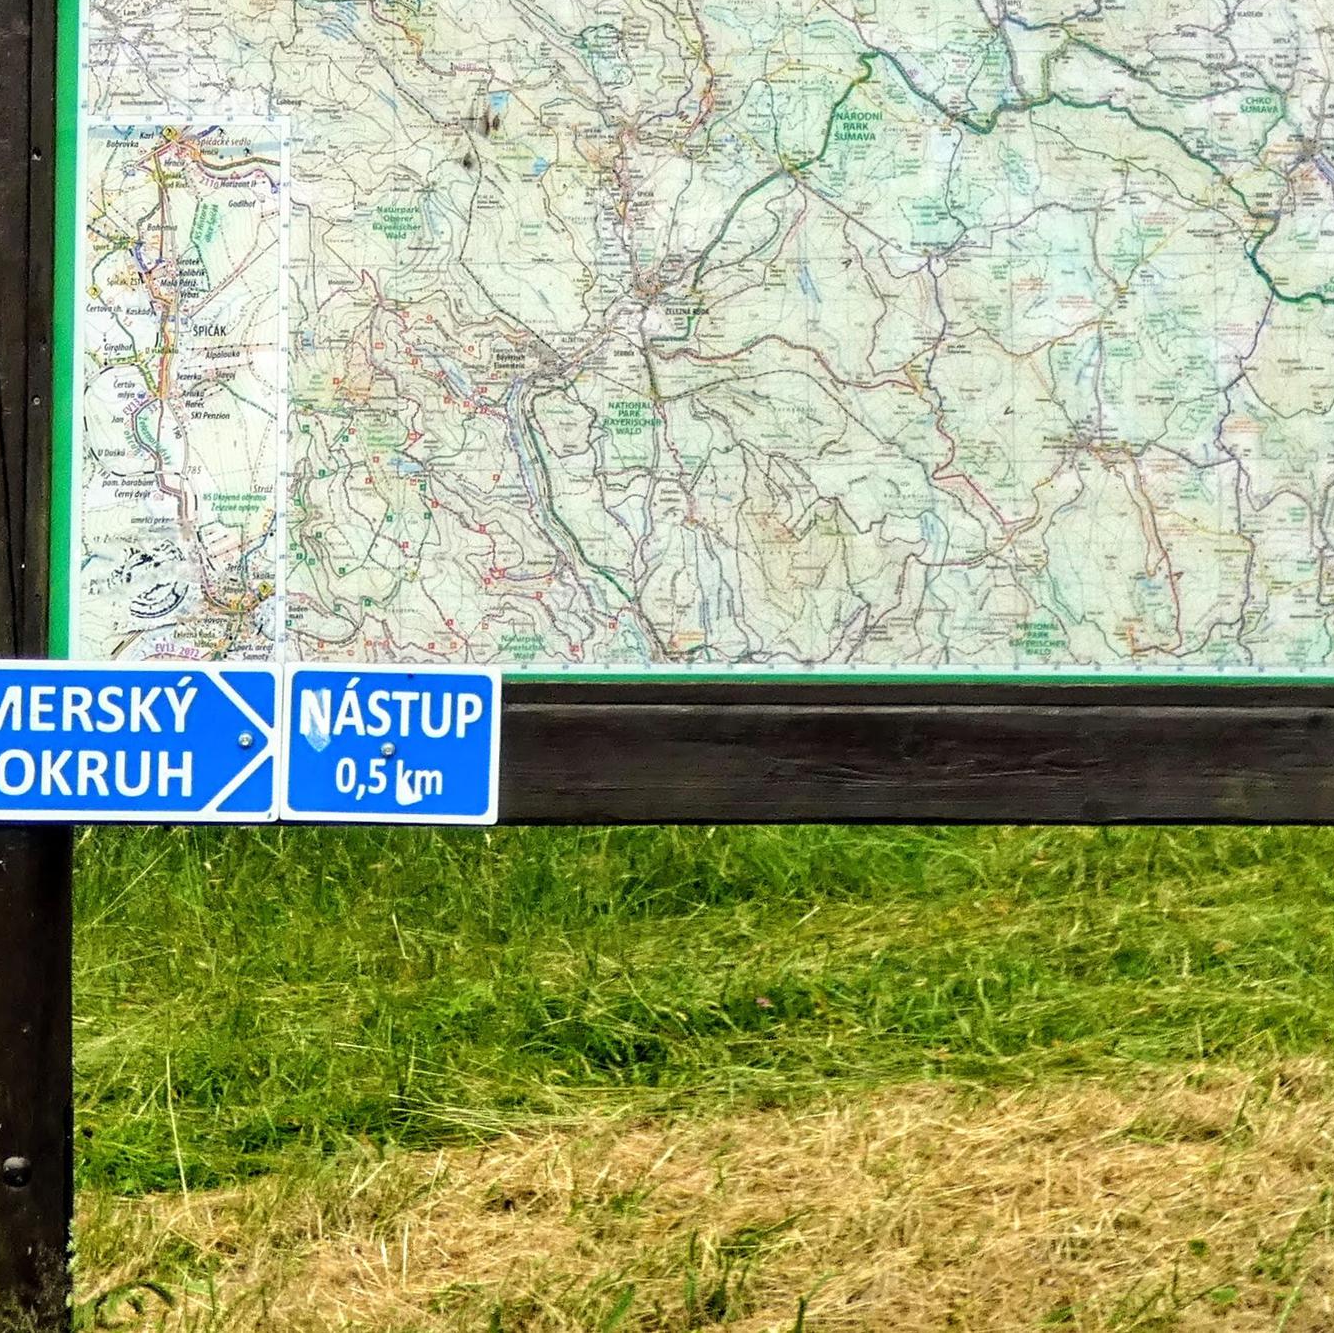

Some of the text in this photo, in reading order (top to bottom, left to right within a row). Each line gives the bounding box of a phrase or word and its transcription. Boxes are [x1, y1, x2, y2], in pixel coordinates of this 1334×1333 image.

[192, 323, 228, 337] ŠPIČÁK
[299, 678, 483, 740] NÁSTUP
[335, 757, 443, 800] 0,5 km
